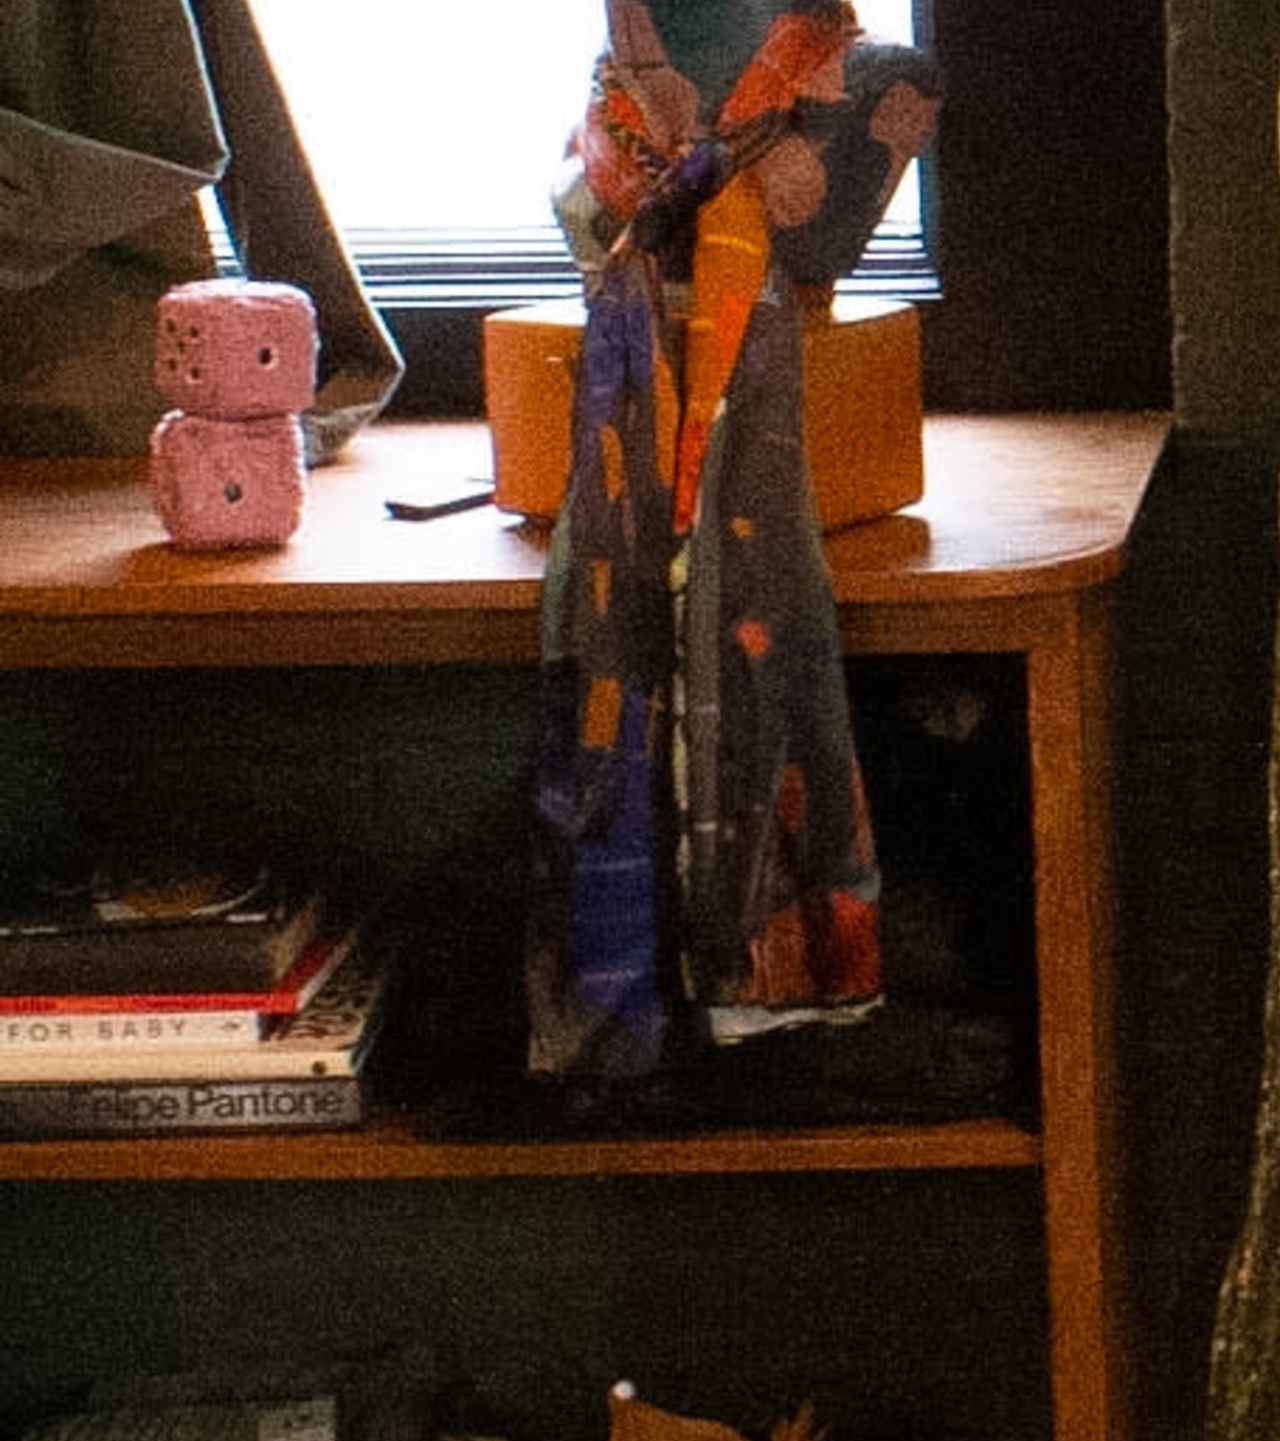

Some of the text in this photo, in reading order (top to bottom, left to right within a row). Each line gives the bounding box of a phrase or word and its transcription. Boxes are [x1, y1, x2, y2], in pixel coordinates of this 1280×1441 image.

[7, 1018, 186, 1043] FOR BABY
[187, 1083, 344, 1118] Pantone
